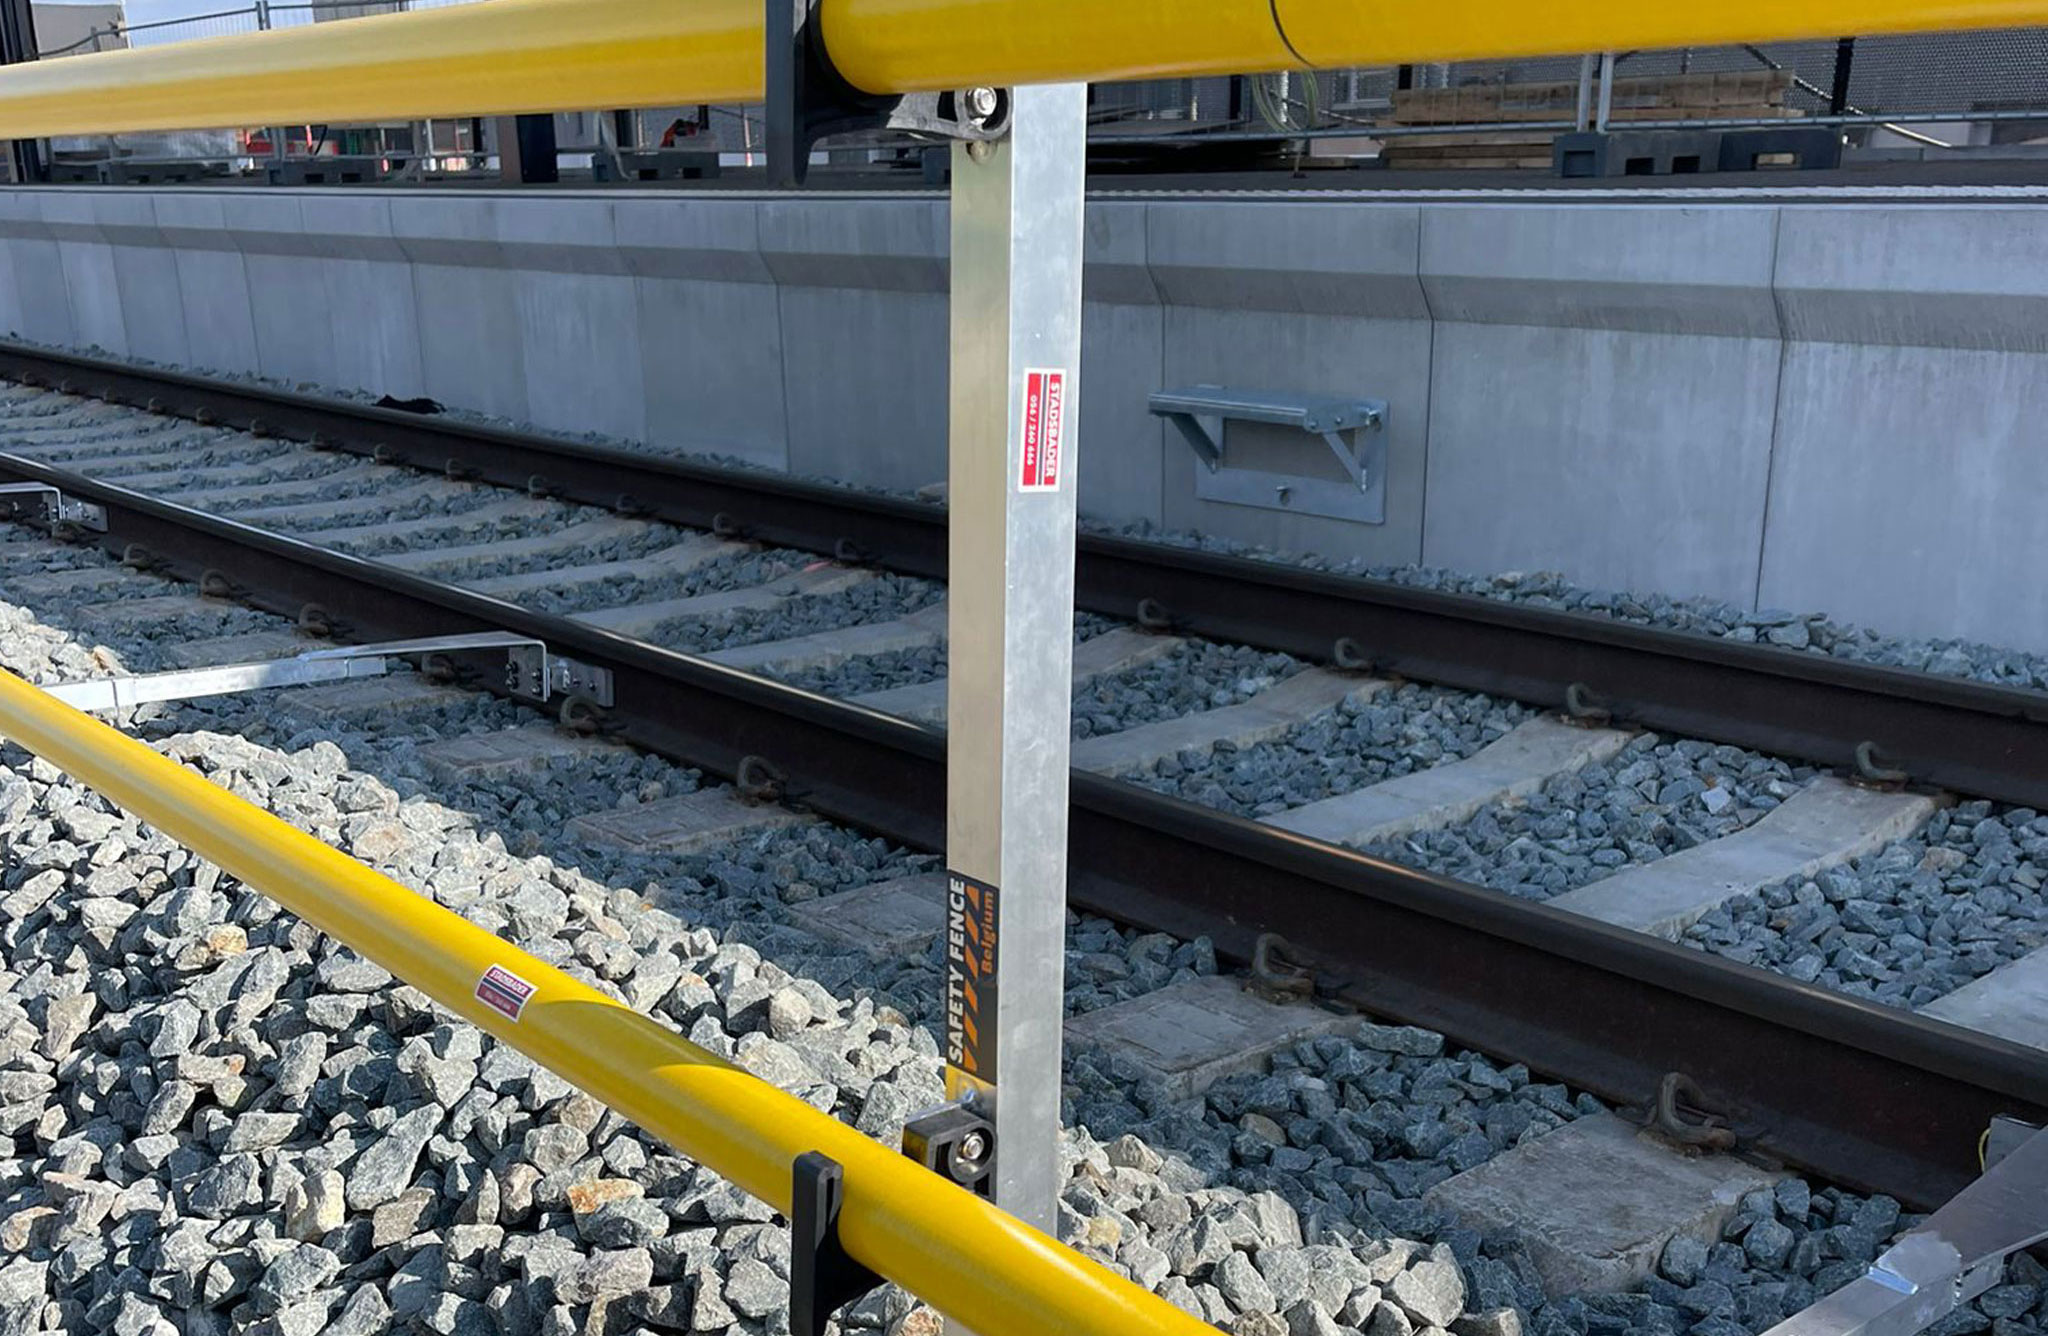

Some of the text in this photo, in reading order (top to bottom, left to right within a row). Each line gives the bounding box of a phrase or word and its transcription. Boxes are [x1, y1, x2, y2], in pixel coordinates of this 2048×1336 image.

[1046, 382, 1060, 477] STADSBADER
[948, 878, 965, 1063] SAFETY FENCE
[981, 891, 996, 974] Belgium
